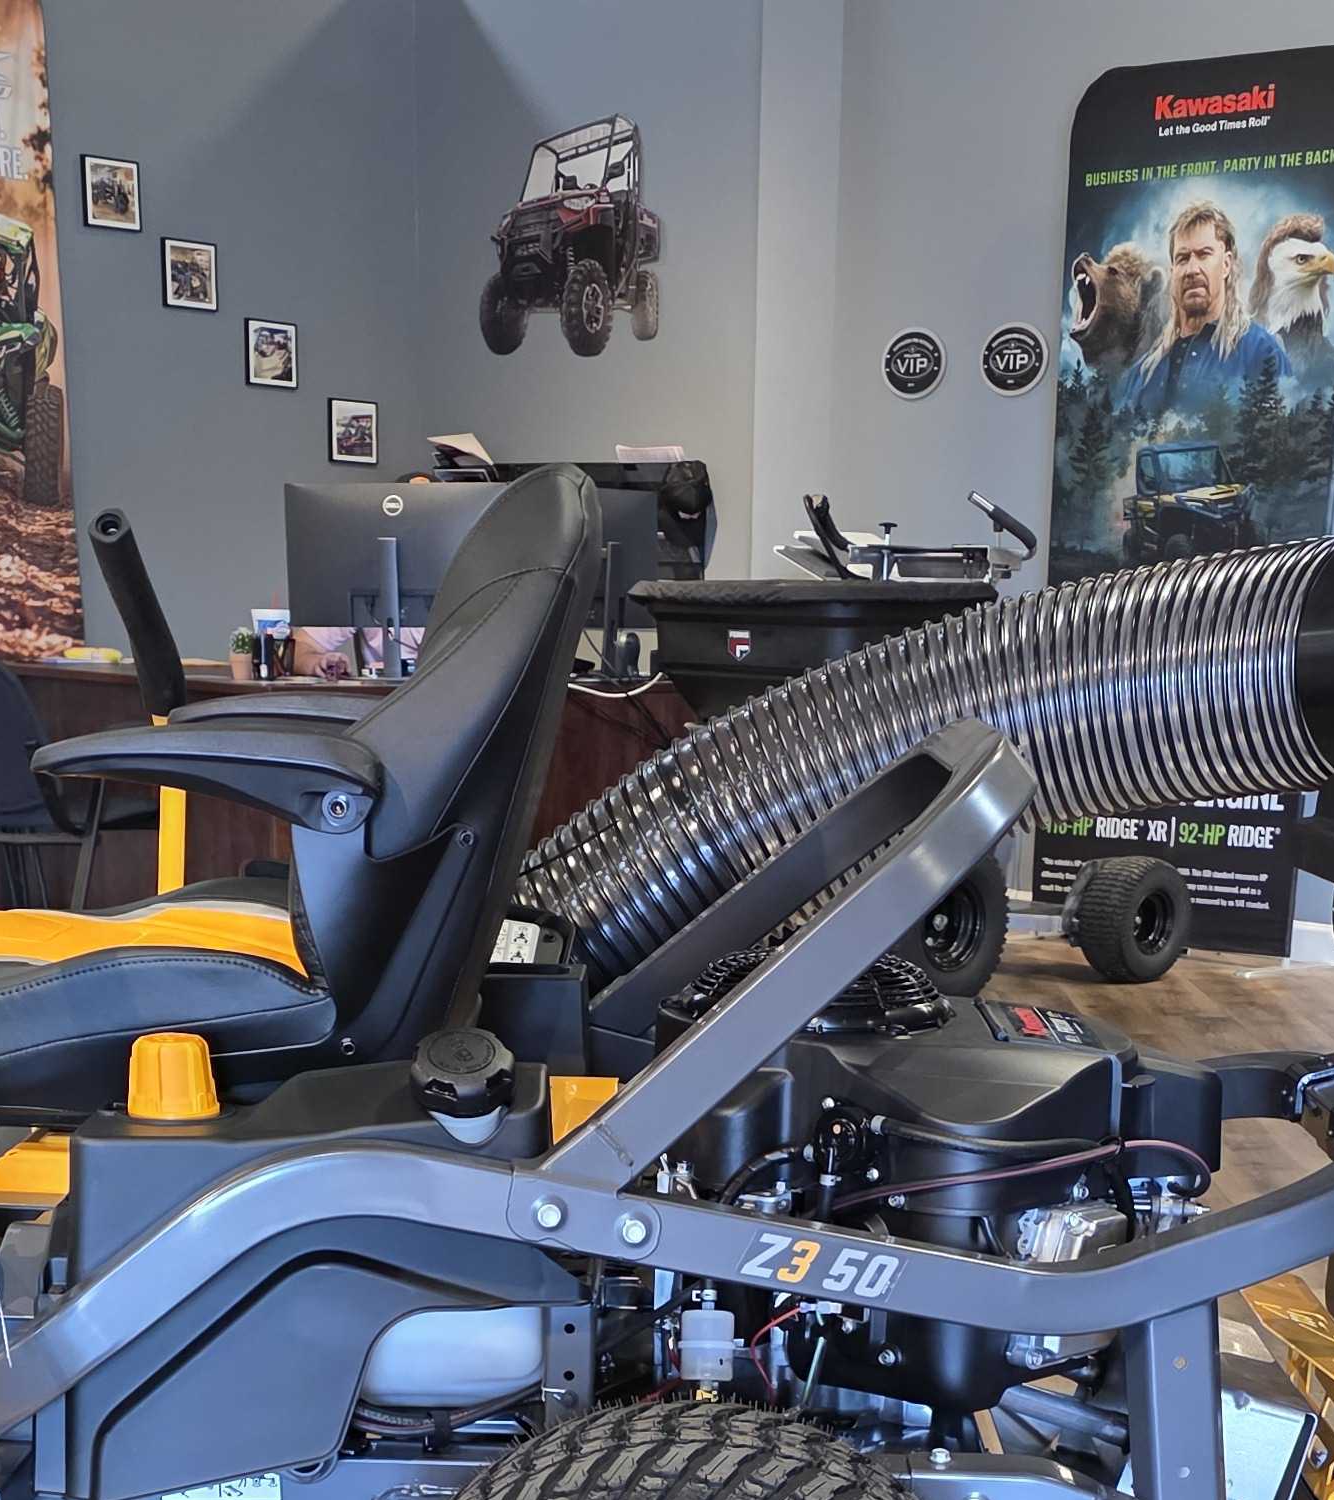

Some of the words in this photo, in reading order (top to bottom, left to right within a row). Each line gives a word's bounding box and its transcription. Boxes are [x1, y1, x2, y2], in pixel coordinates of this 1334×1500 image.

[1154, 83, 1276, 121] Kawasaki
[1158, 126, 1174, 137] Let
[1175, 124, 1191, 135] the
[1192, 122, 1217, 134] Good
[1219, 119, 1247, 131] Times
[1085, 169, 1139, 188] BUSINESS
[1141, 167, 1153, 181] IN
[1156, 164, 1178, 179] THE
[1180, 160, 1220, 177] FRONT.
[1223, 155, 1261, 173] PARTY
[1263, 154, 1277, 169] IN
[1279, 152, 1303, 168] THE
[896, 357, 928, 374] VIP
[995, 353, 1029, 370] VIP
[1147, 820, 1168, 842] XR
[1178, 821, 1226, 845] 92-HP
[740, 1233, 821, 1284] Z3
[822, 1247, 900, 1298] 50
